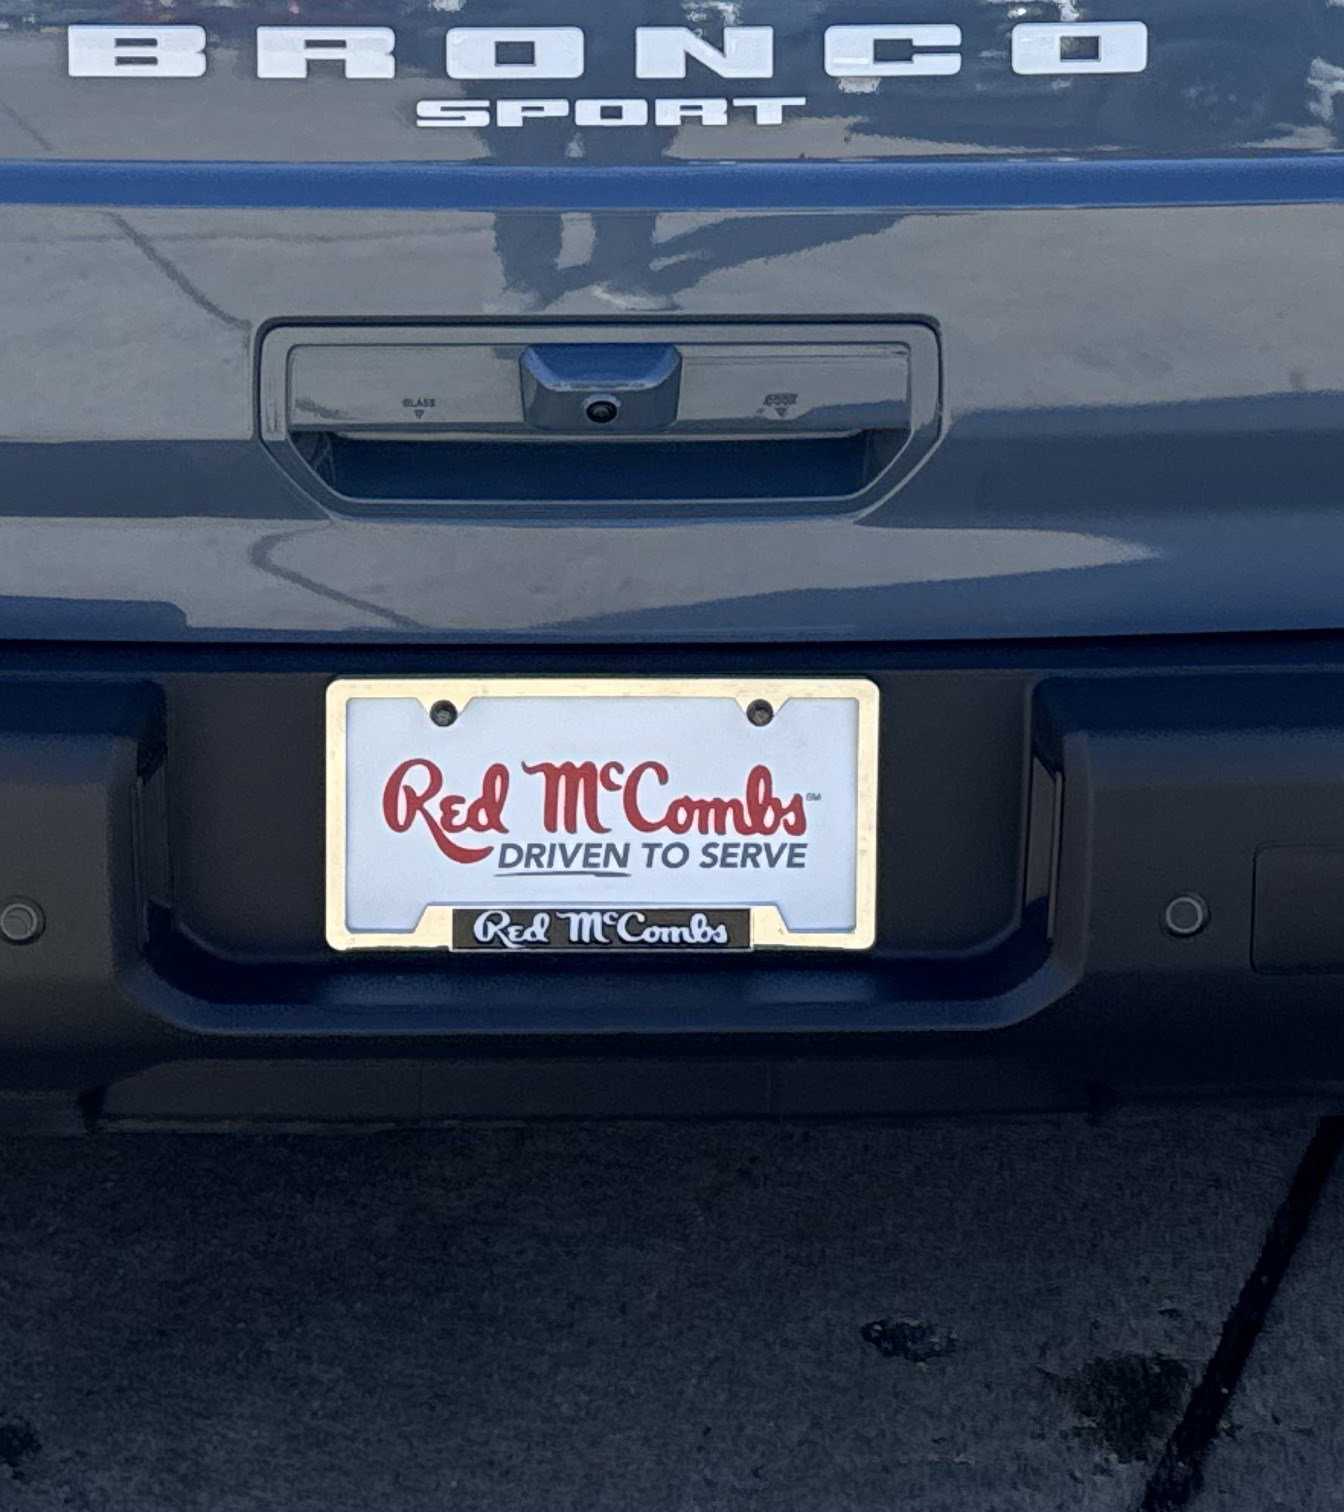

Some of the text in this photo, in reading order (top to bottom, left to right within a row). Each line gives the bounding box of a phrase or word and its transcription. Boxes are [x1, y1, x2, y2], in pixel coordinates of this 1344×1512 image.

[67, 20, 1148, 80] BRONCO
[415, 96, 807, 129] SPORT
[382, 757, 509, 864] Red
[521, 759, 808, 836] McCombs
[497, 842, 808, 869] DRIVEN TO SERVE
[473, 909, 729, 948] Red McCombs
